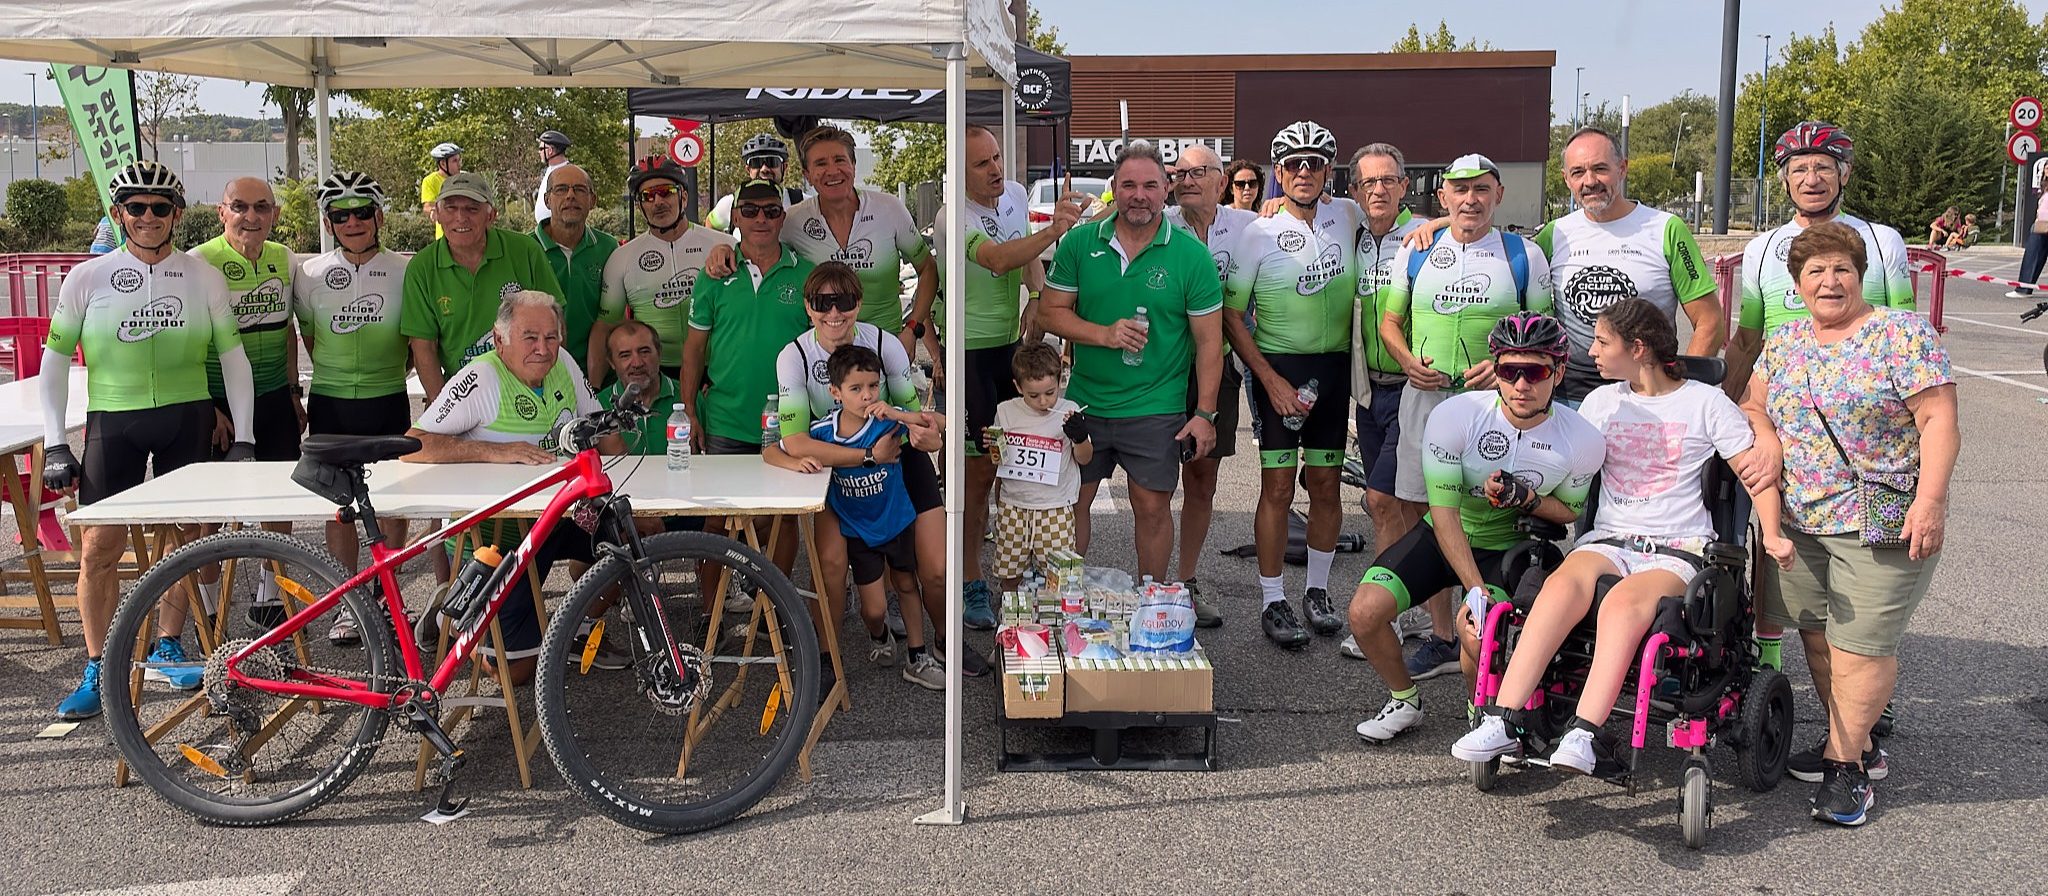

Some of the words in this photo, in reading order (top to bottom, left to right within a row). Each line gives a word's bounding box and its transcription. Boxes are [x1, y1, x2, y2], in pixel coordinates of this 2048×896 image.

[1020, 68, 1052, 88] AUTHENTIC
[1023, 84, 1043, 94] BCF
[1031, 89, 1052, 110] QUALITY
[2018, 108, 2036, 120] 20
[1306, 259, 1337, 272] ciclos
[1676, 240, 1700, 281] CORREDOR
[1298, 266, 1345, 283] corredor
[1358, 276, 1392, 285] corredo
[661, 280, 694, 290] ciclos
[1444, 284, 1480, 294] ciclos
[1577, 283, 1622, 291] CICLISTA
[240, 291, 280, 305] ciclos
[655, 287, 692, 299] corred
[1435, 293, 1490, 304] corredor
[132, 308, 173, 318] ciclos
[232, 301, 286, 316] corredor
[342, 304, 374, 313] ciclos
[121, 318, 186, 328] corredor
[332, 314, 384, 322] corredor
[448, 369, 479, 402] Rivas
[439, 397, 451, 413] CLUB
[435, 402, 456, 424] CICLISTA
[1005, 434, 1026, 446] XXIX
[1531, 441, 1552, 451] GOBIK
[1482, 442, 1506, 455] Rivas
[1015, 448, 1046, 469] 351
[833, 467, 888, 488] Emirates
[854, 482, 883, 498] BETTER
[455, 531, 533, 660] MERIDA
[309, 741, 360, 798] MAXXIS
[590, 779, 653, 817] MAXXIS
